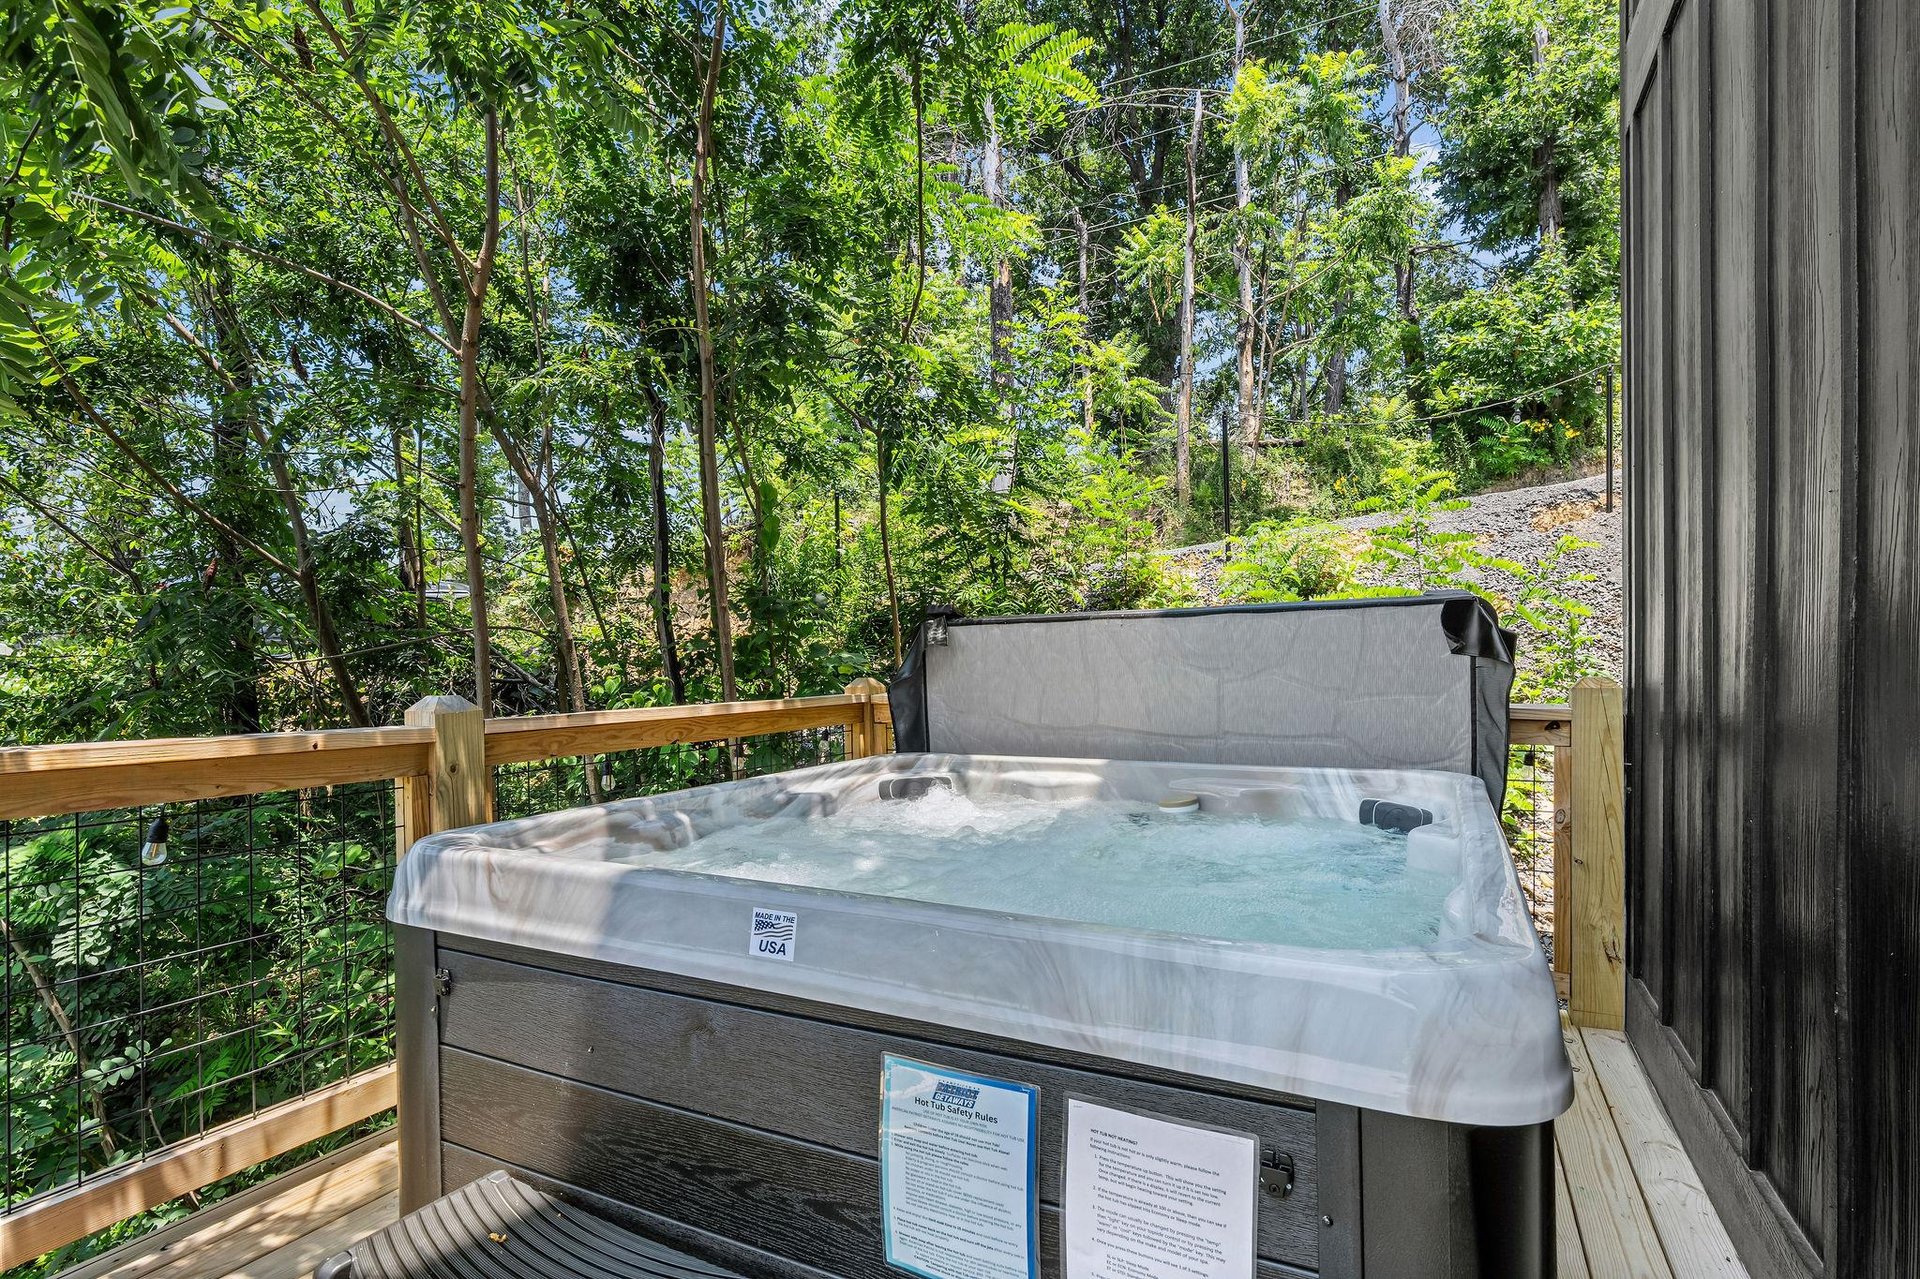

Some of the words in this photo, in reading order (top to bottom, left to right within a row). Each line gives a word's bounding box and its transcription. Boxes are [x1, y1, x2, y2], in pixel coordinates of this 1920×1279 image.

[754, 912, 774, 920] MADE
[782, 916, 796, 924] THE
[758, 940, 786, 956] USA
[934, 1091, 974, 1109] GETAWAYS
[914, 1096, 929, 1107] Hot
[930, 1100, 946, 1112] Tub
[947, 1104, 973, 1120] Safety
[974, 1111, 998, 1124] Rules
